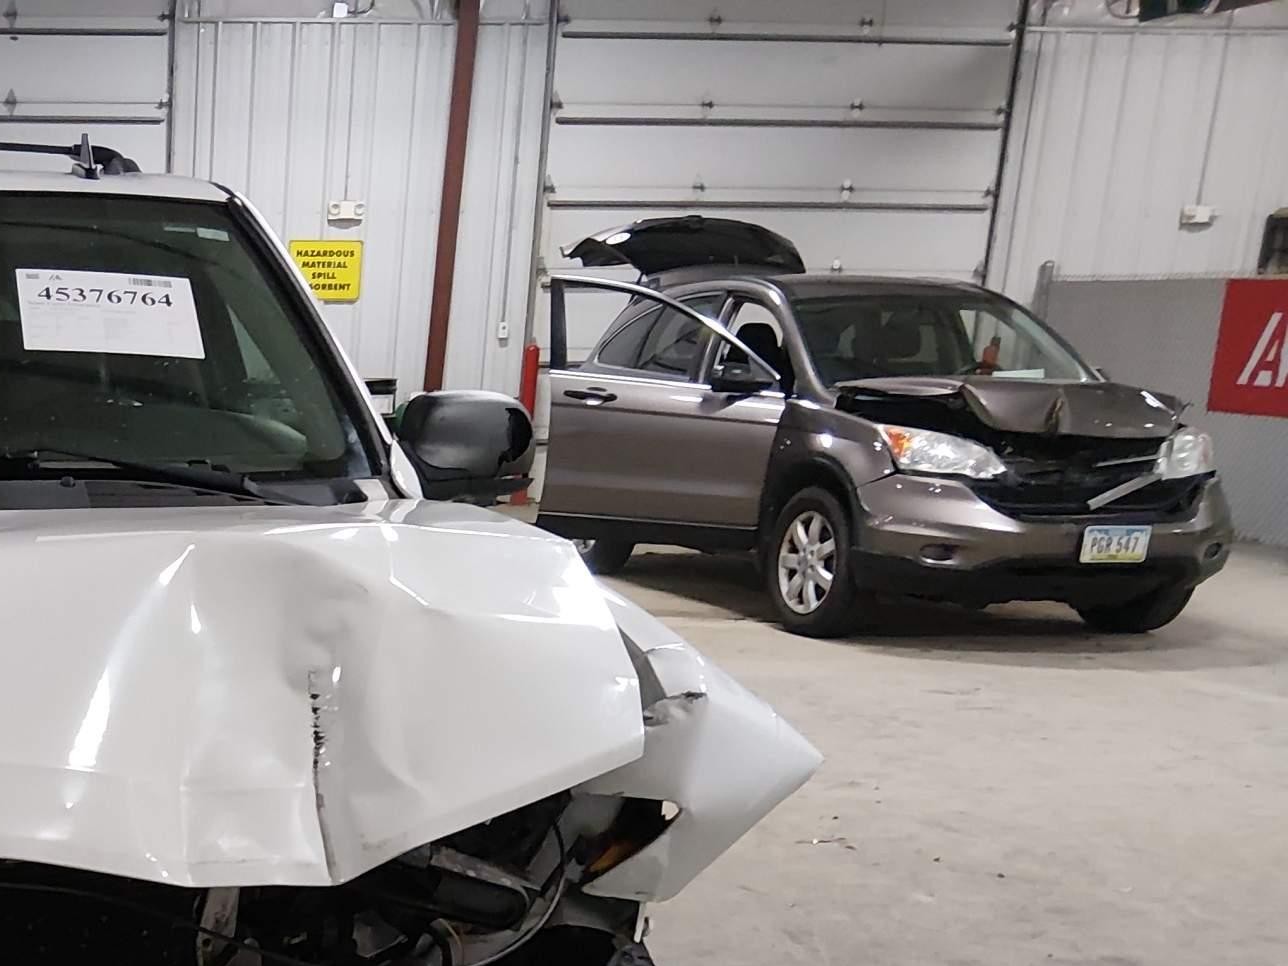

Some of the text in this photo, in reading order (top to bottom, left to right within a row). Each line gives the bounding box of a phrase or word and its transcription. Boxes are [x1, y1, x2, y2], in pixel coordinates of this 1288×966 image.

[296, 249, 355, 257] HAZARDOUS
[301, 261, 348, 269] MATERIAL
[312, 272, 337, 280] SPILL
[37, 286, 173, 308] 45376764
[1115, 535, 1140, 553] 547
